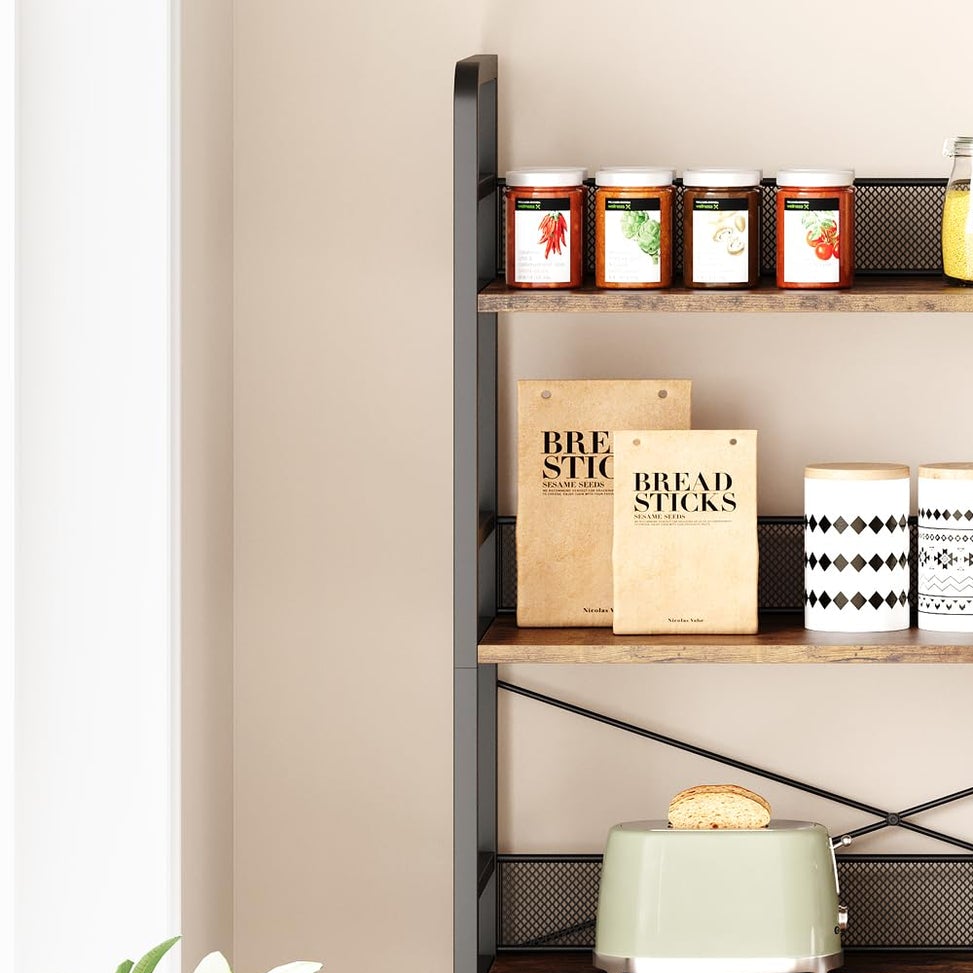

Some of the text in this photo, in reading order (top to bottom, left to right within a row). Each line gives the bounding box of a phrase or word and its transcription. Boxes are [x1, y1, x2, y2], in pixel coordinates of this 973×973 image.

[541, 431, 614, 454] BRE
[543, 455, 614, 479] STIC
[633, 472, 733, 491] BREAD
[634, 492, 737, 512] STICKS
